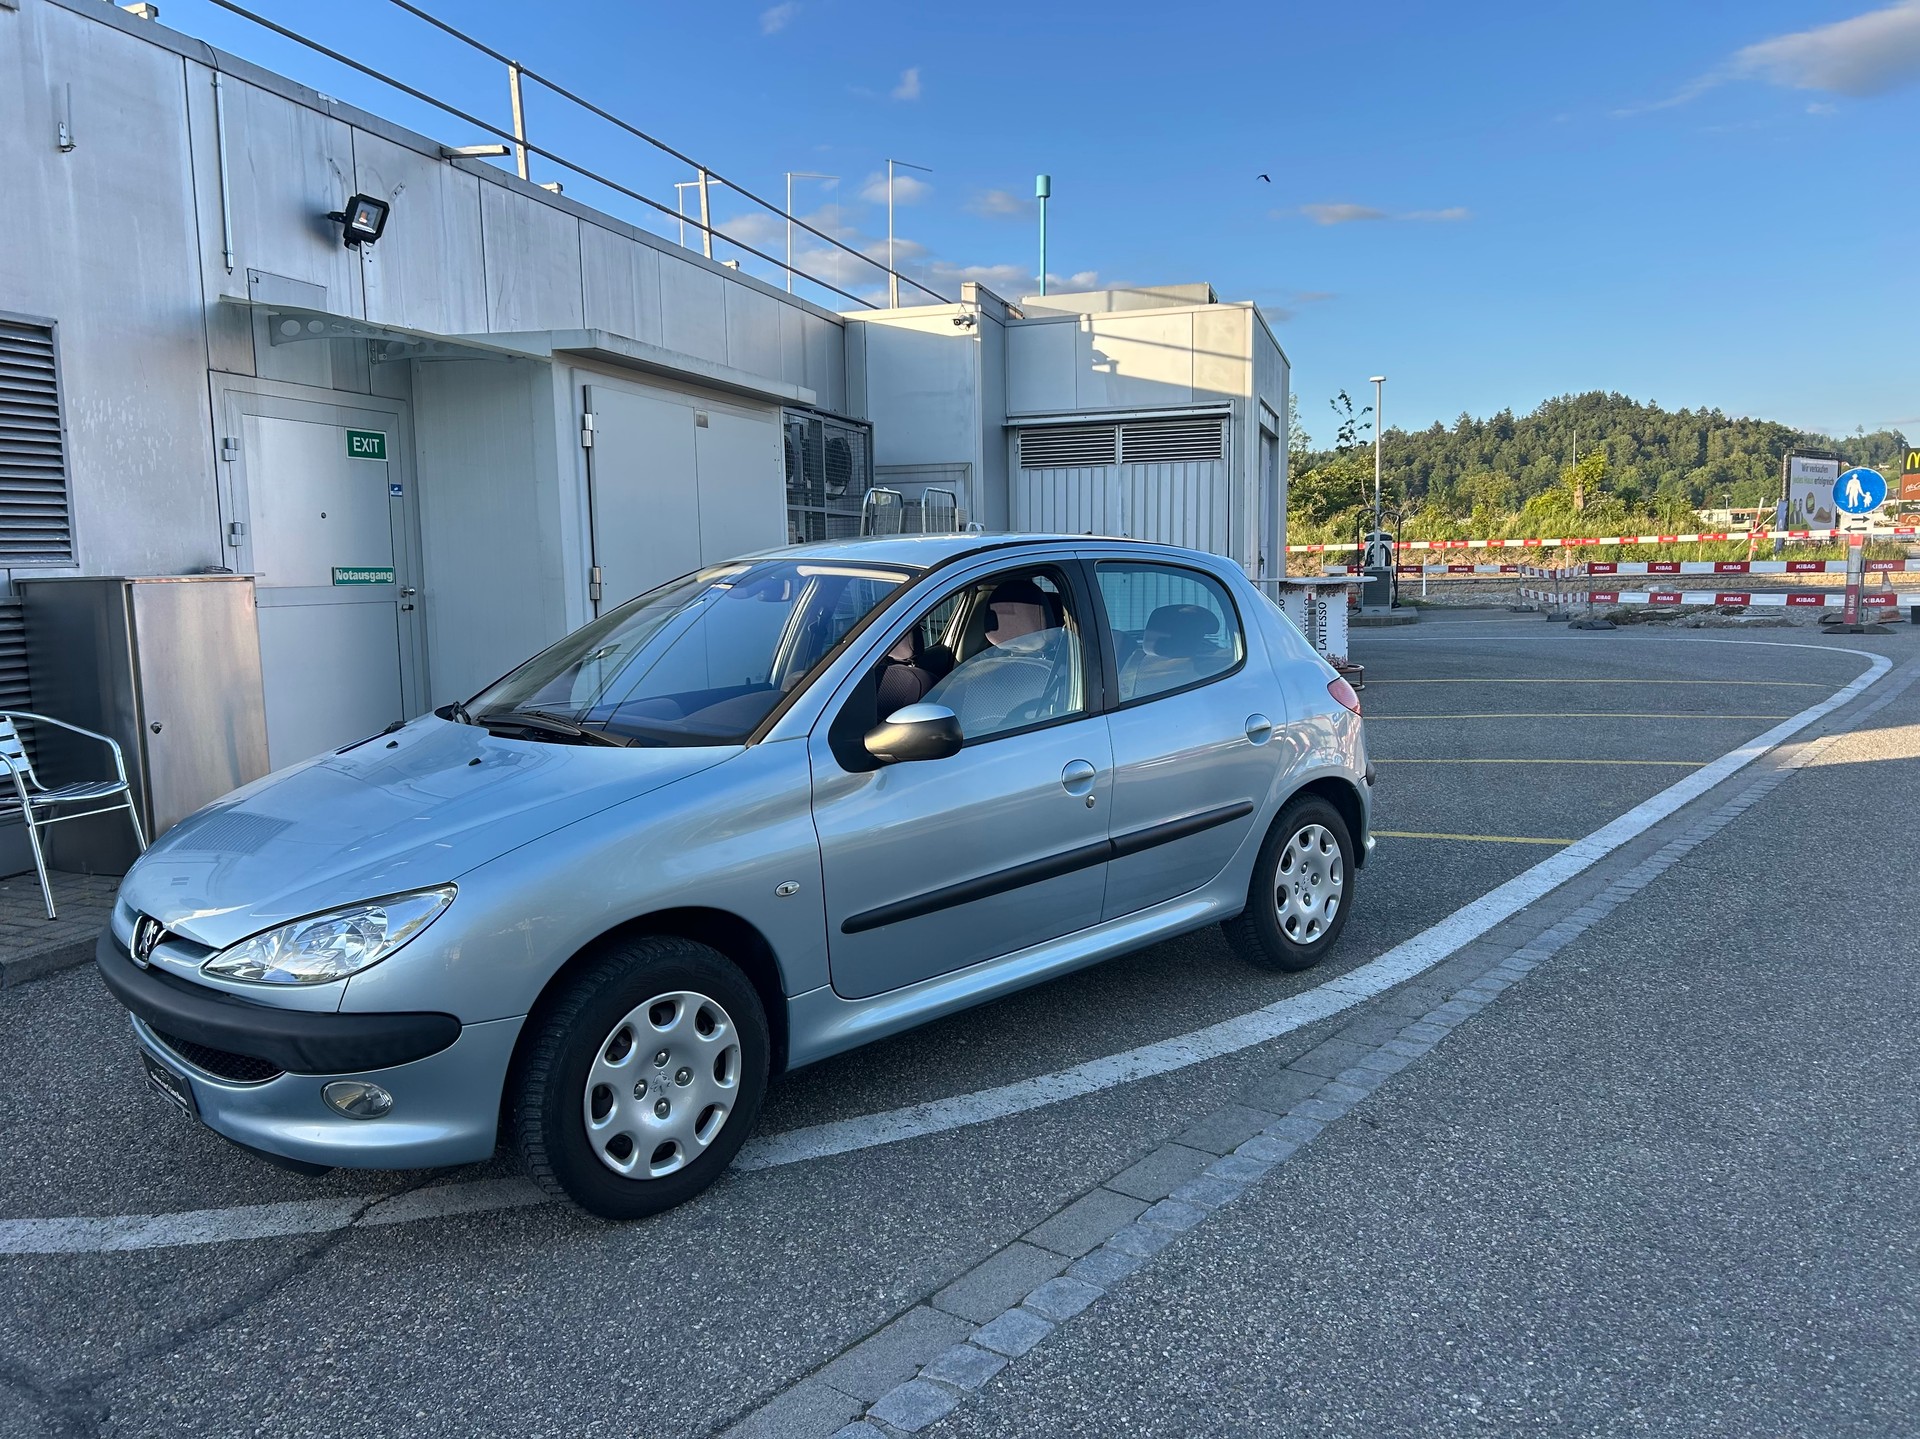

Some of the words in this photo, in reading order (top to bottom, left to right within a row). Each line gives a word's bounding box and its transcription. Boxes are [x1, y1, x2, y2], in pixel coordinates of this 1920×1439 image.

[352, 436, 380, 453] EXIT
[1810, 464, 1828, 473] verkaufen
[1814, 477, 1835, 488] erfolgreich
[335, 569, 394, 583] Notausgang
[1847, 594, 1856, 615] KIBAG
[1317, 601, 1327, 651] LATTESSO
